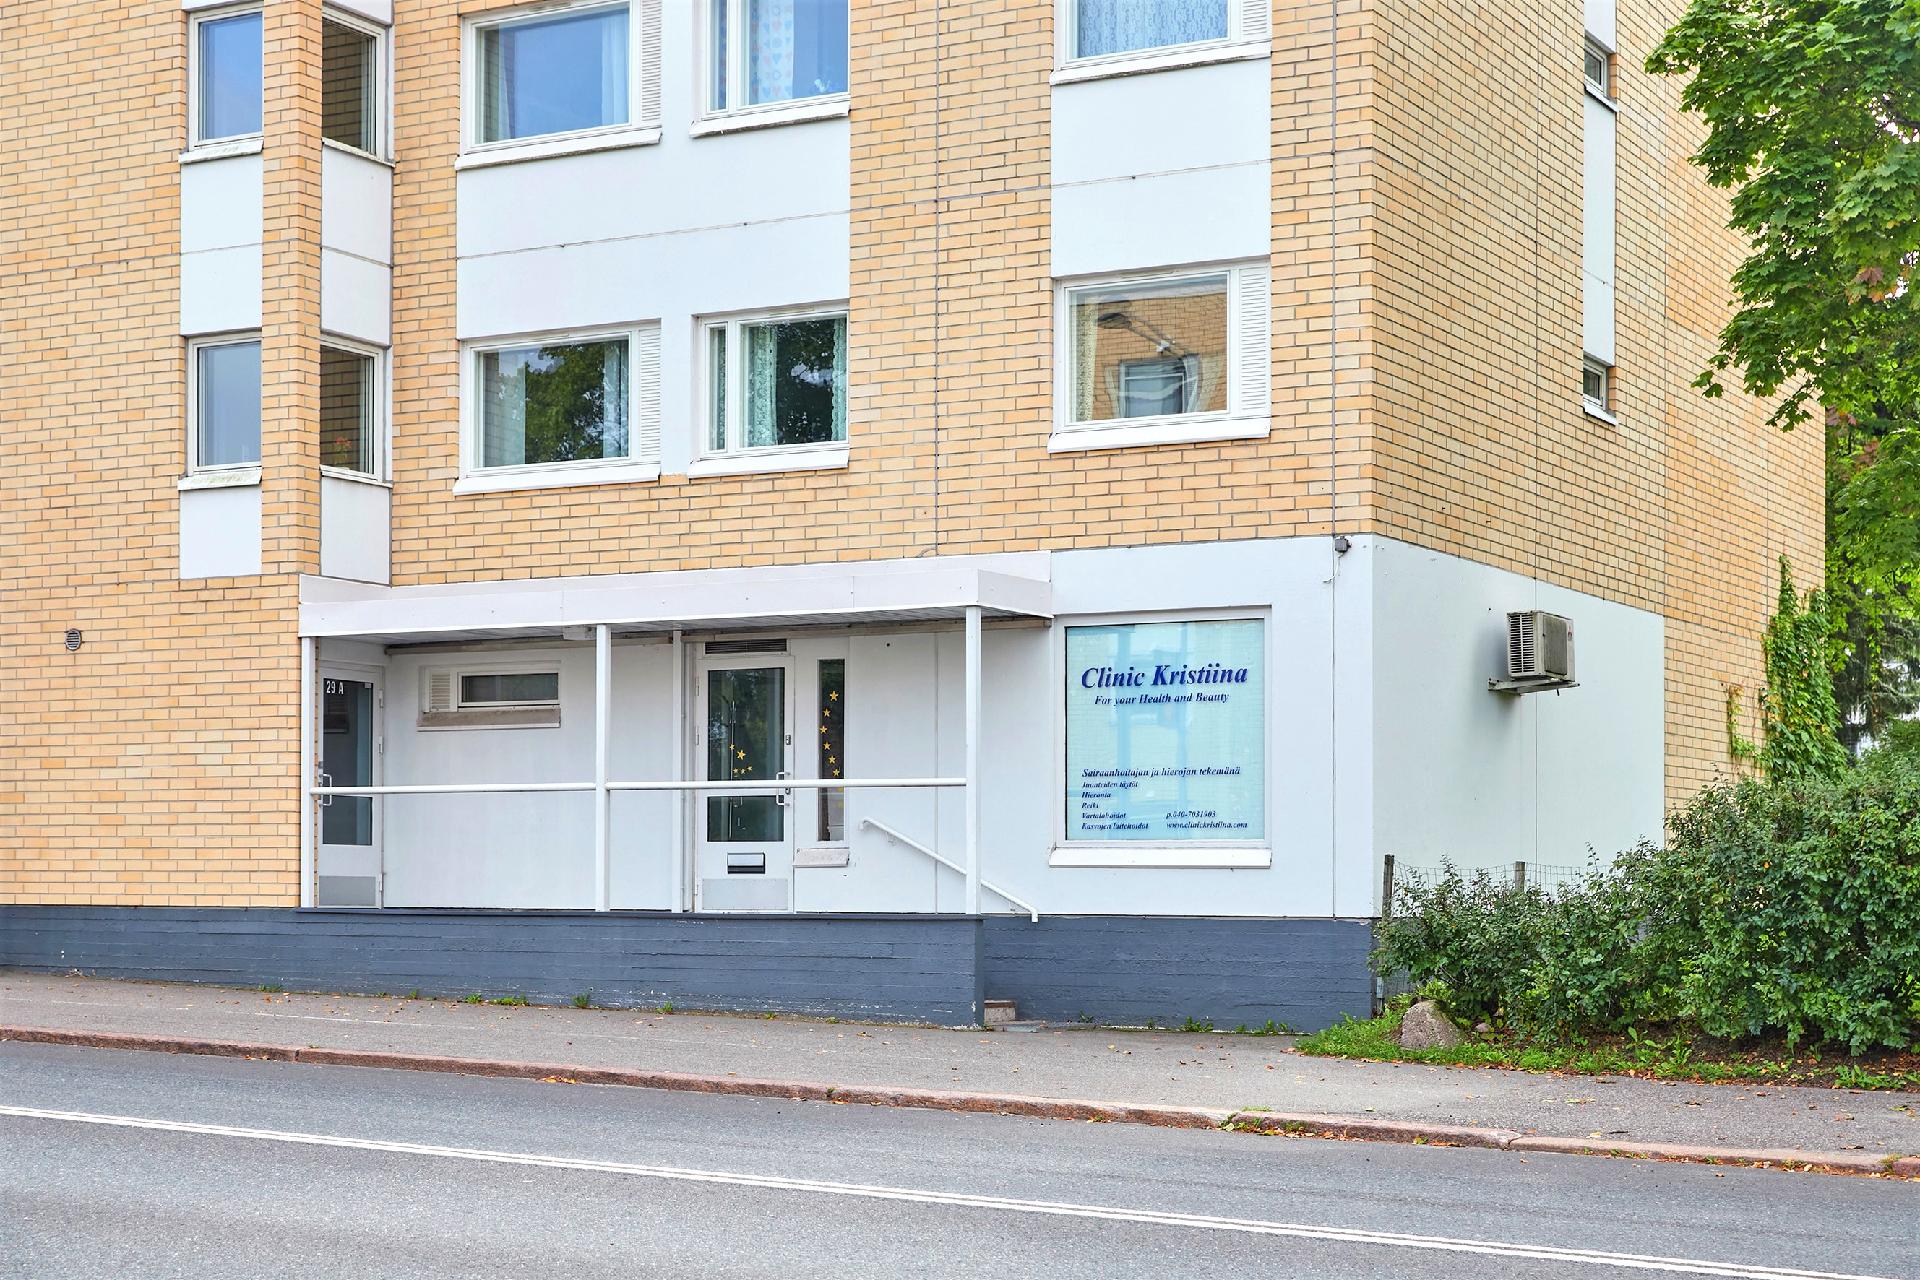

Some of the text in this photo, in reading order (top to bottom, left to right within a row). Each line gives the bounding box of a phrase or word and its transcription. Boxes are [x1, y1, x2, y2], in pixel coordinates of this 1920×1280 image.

[1081, 662, 1249, 689] Clinic Kristiina
[326, 680, 344, 694] 29 A
[1094, 692, 1230, 707] For your Health and Beauty
[1081, 766, 1241, 778] Sairaanhoitajan ja hierojan tekemänä
